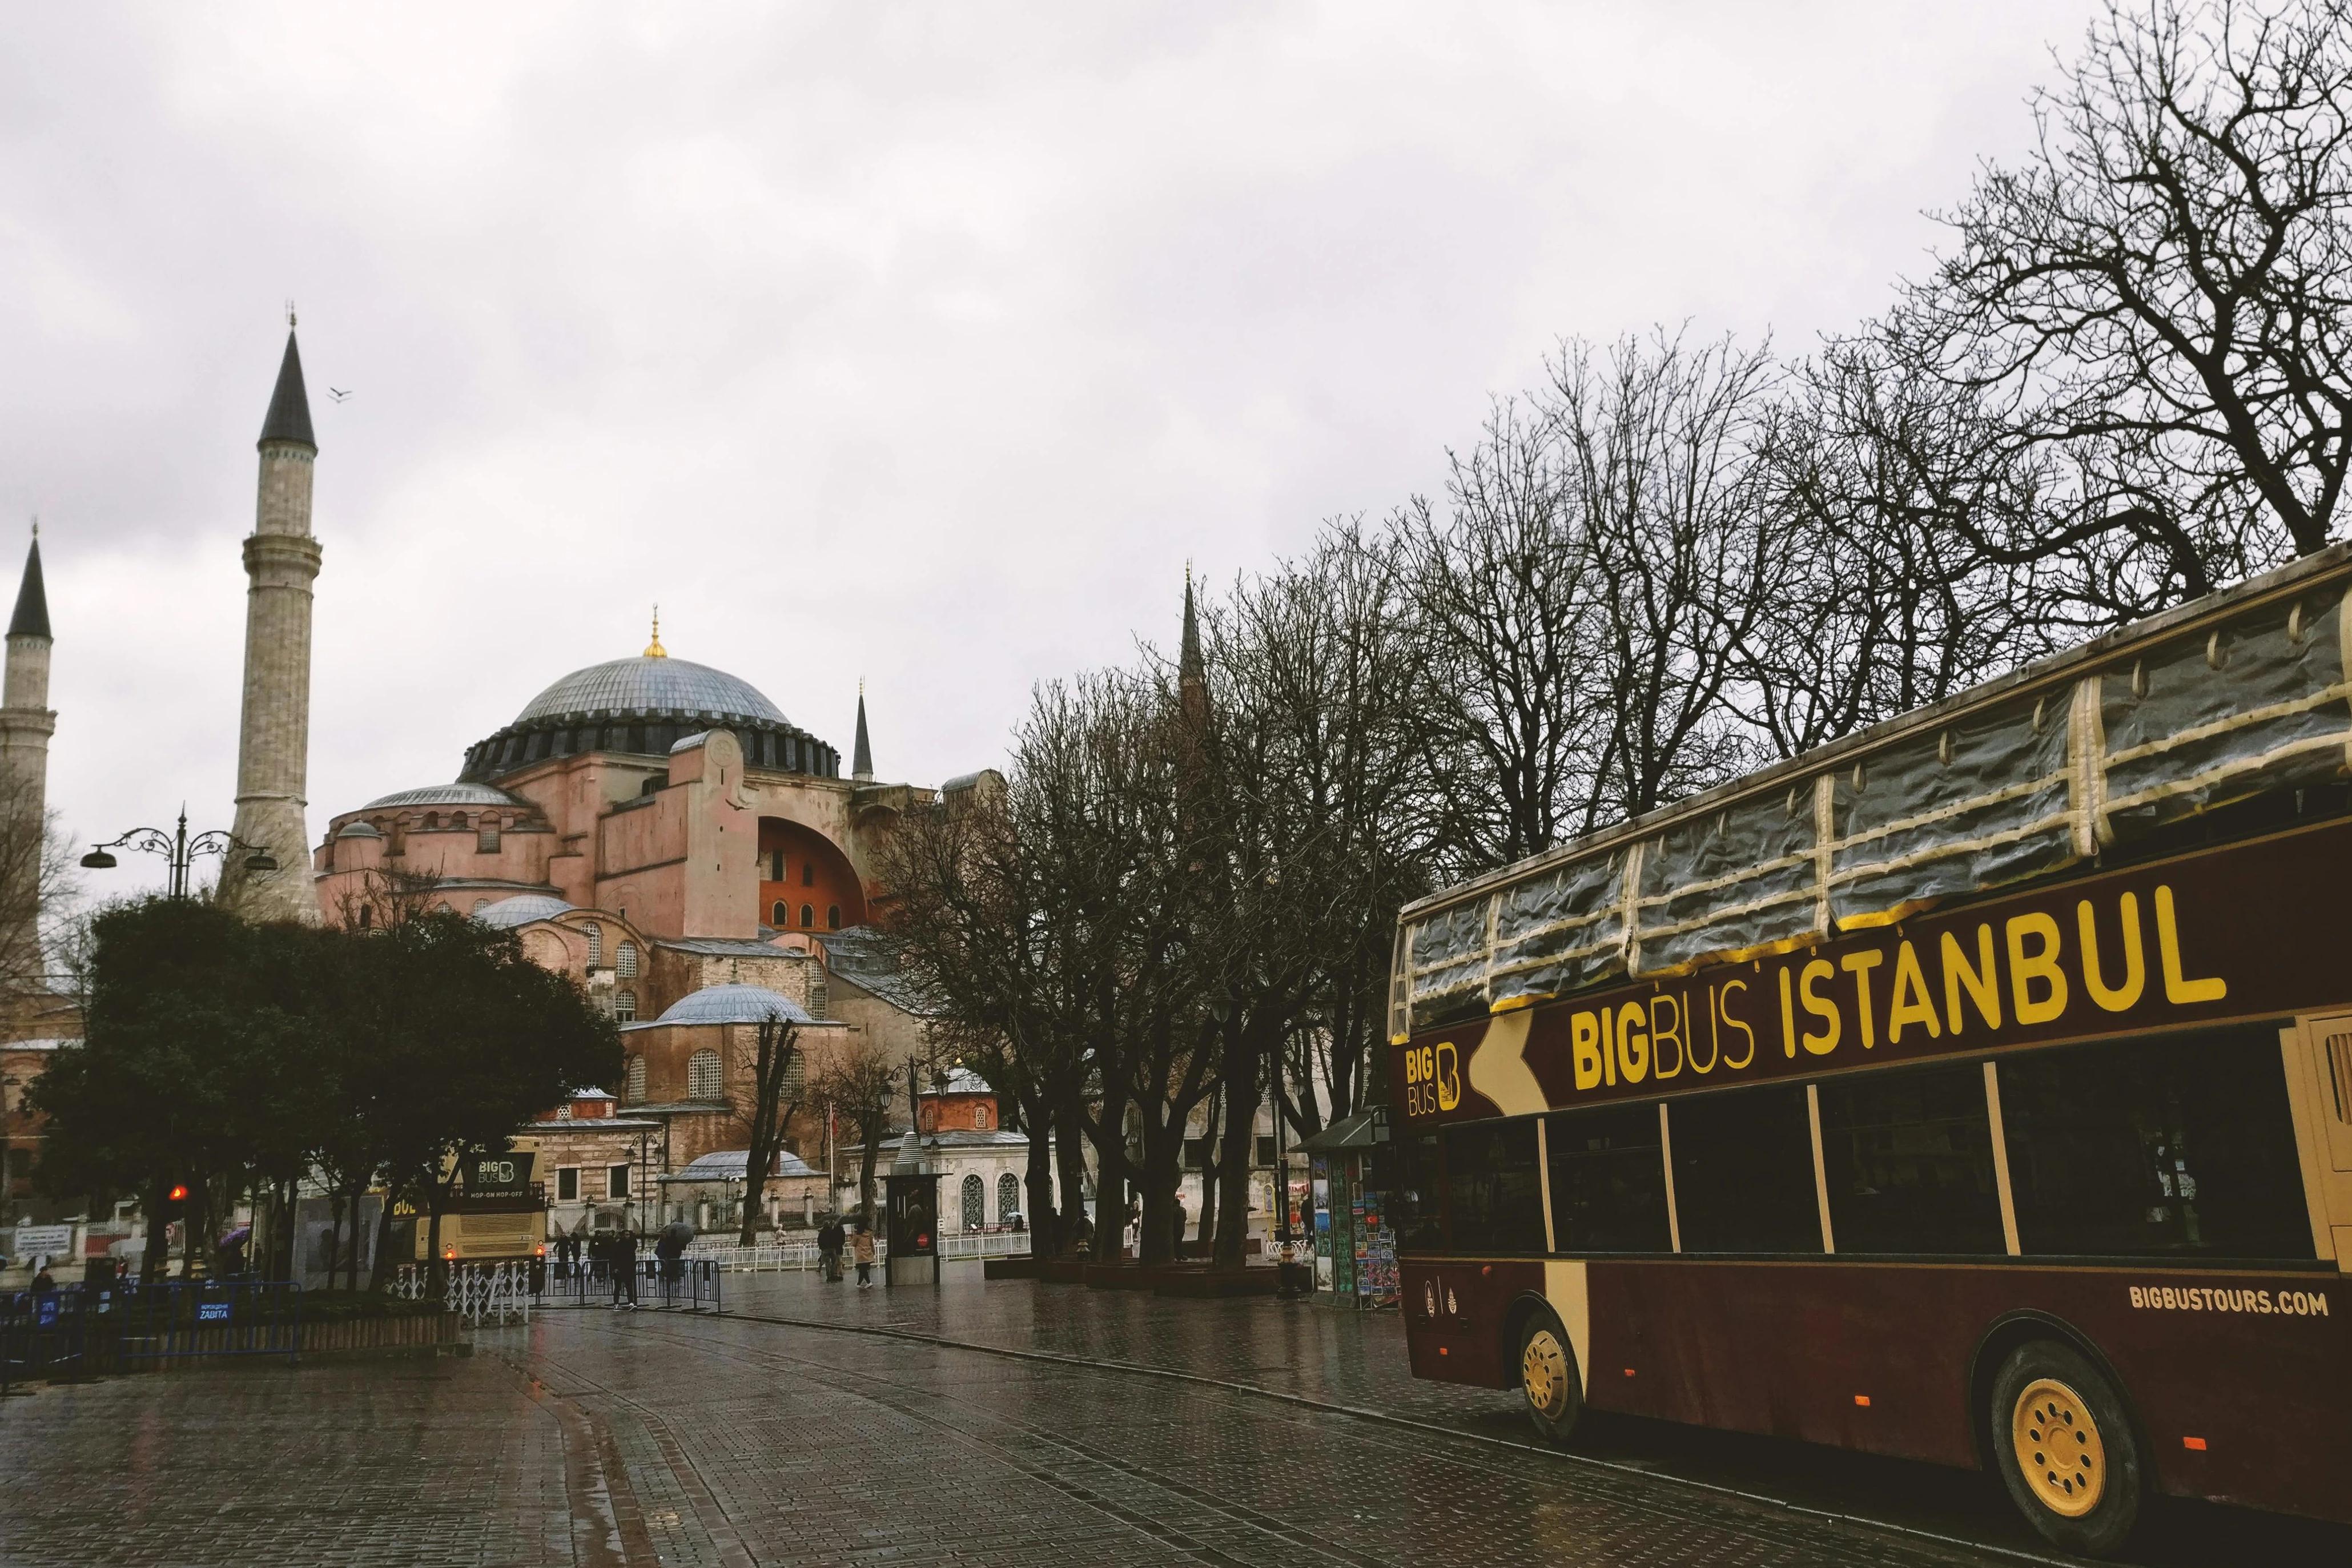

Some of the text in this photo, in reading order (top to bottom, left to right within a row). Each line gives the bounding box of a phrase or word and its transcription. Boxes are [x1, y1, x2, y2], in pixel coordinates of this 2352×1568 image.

[1779, 884, 2227, 1059] ISTANBUL
[1406, 1046, 1433, 1084] BIG
[1408, 1083, 1436, 1116] BUS
[479, 1161, 498, 1172] BIG
[479, 1172, 498, 1183] BUS
[200, 1310, 227, 1319] ZABITA
[2129, 1286, 2329, 1316] BIGBUSTOURS.COM
